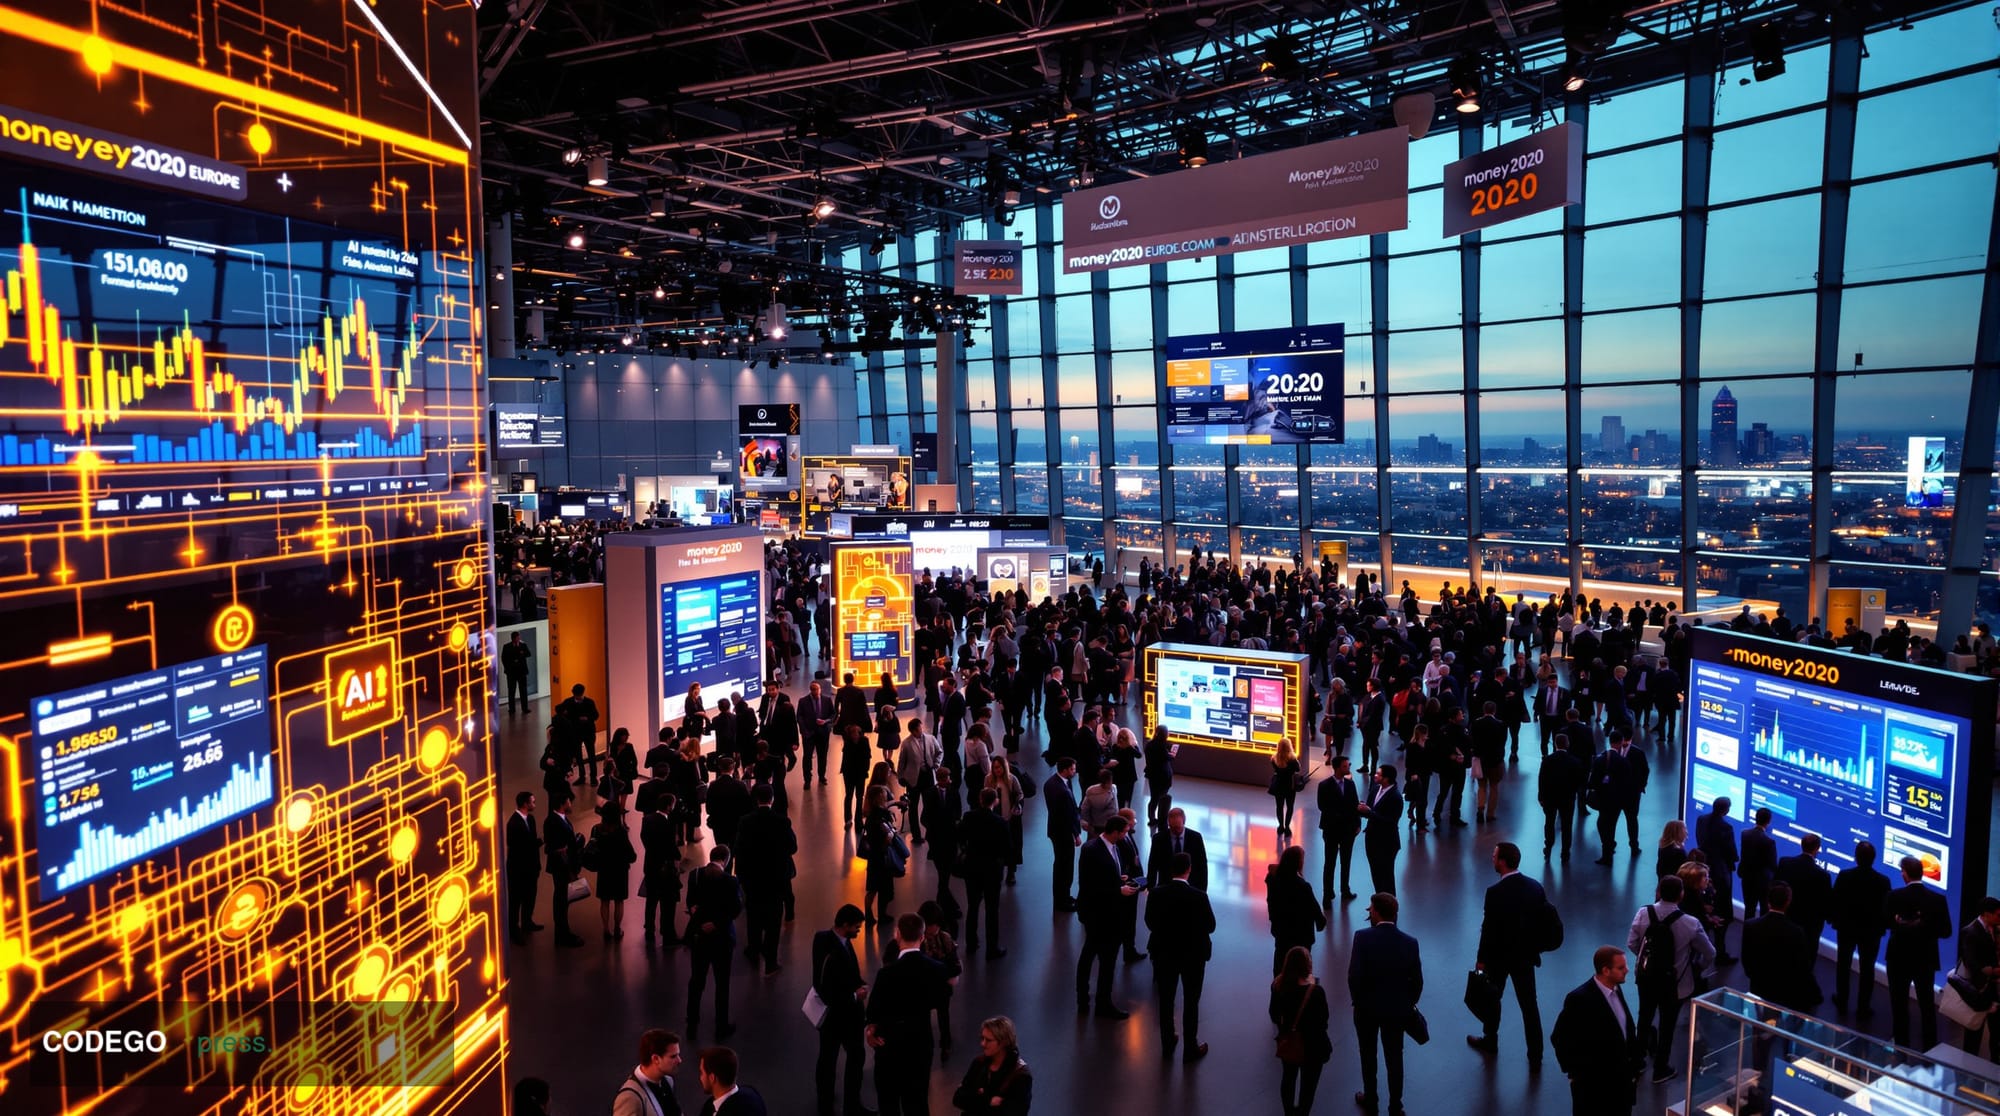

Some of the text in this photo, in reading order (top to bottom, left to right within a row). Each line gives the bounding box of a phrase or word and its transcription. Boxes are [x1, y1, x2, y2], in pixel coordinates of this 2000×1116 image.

[189, 164, 240, 190] EUROPE
[1464, 149, 1544, 187] money2020
[33, 191, 68, 212] NAIK
[1471, 172, 1538, 217] 2020
[1069, 245, 1143, 268] money2020
[1266, 372, 1324, 395] 20:20
[1733, 648, 1840, 684] money2020
[345, 671, 373, 708] AI
[1906, 786, 1929, 808] 15
